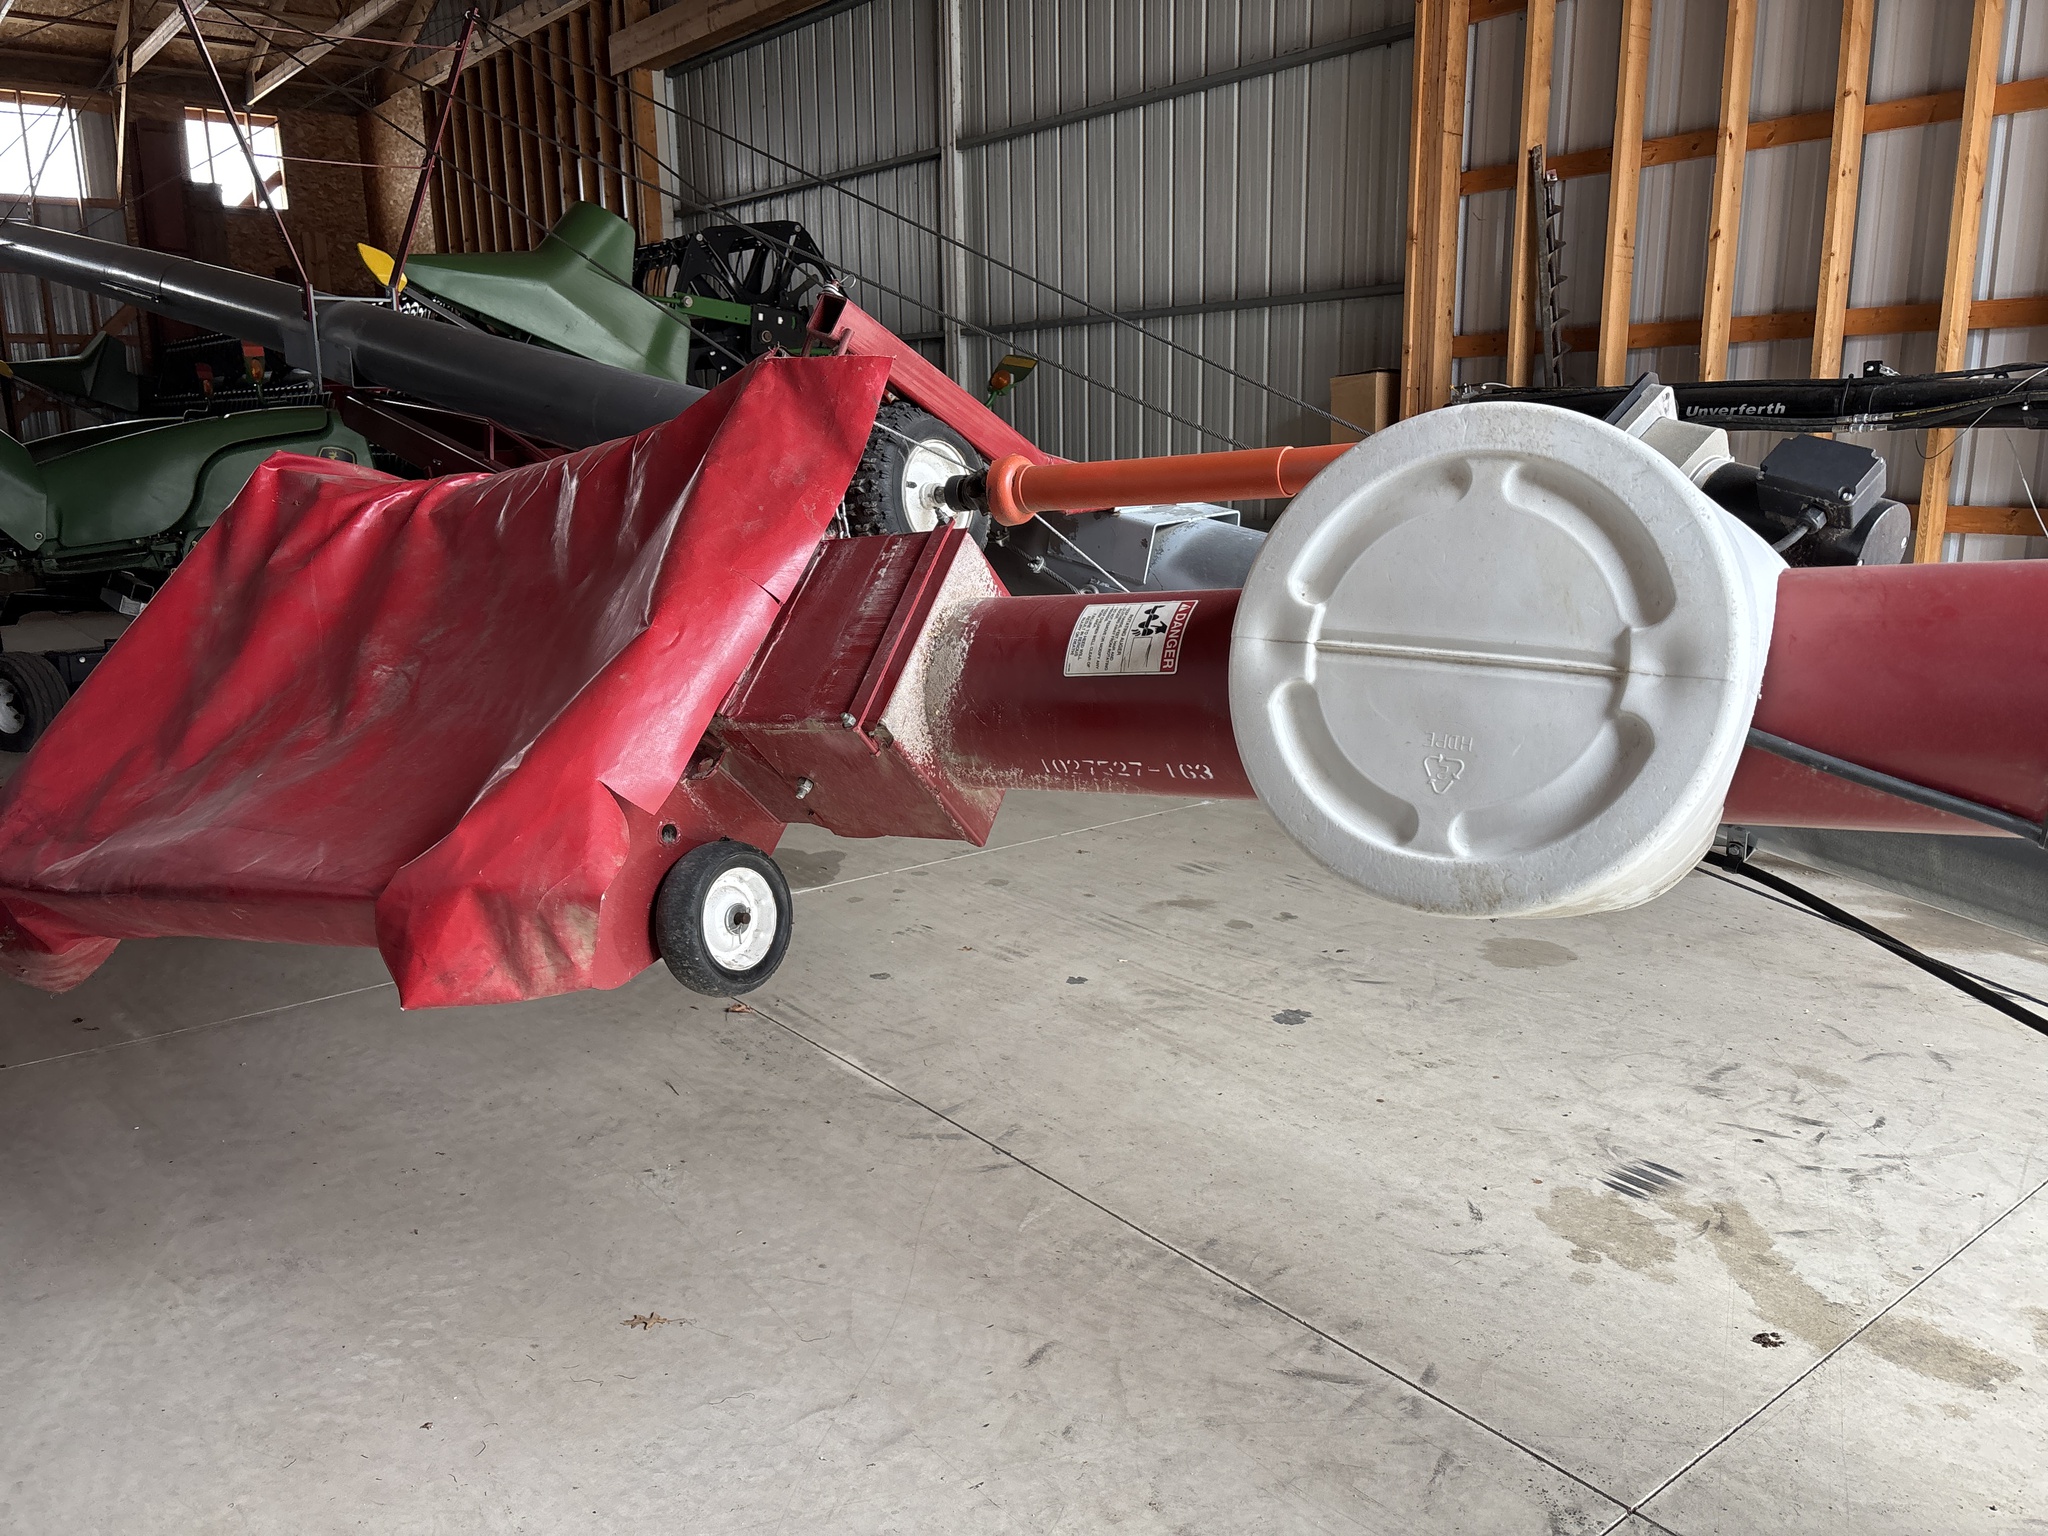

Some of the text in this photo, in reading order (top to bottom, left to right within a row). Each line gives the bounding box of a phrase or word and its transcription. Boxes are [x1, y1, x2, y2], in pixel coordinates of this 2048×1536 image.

[1685, 402, 1786, 417] Unverferth
[1162, 613, 1185, 669] DANGER
[1422, 732, 1473, 752] HDPE
